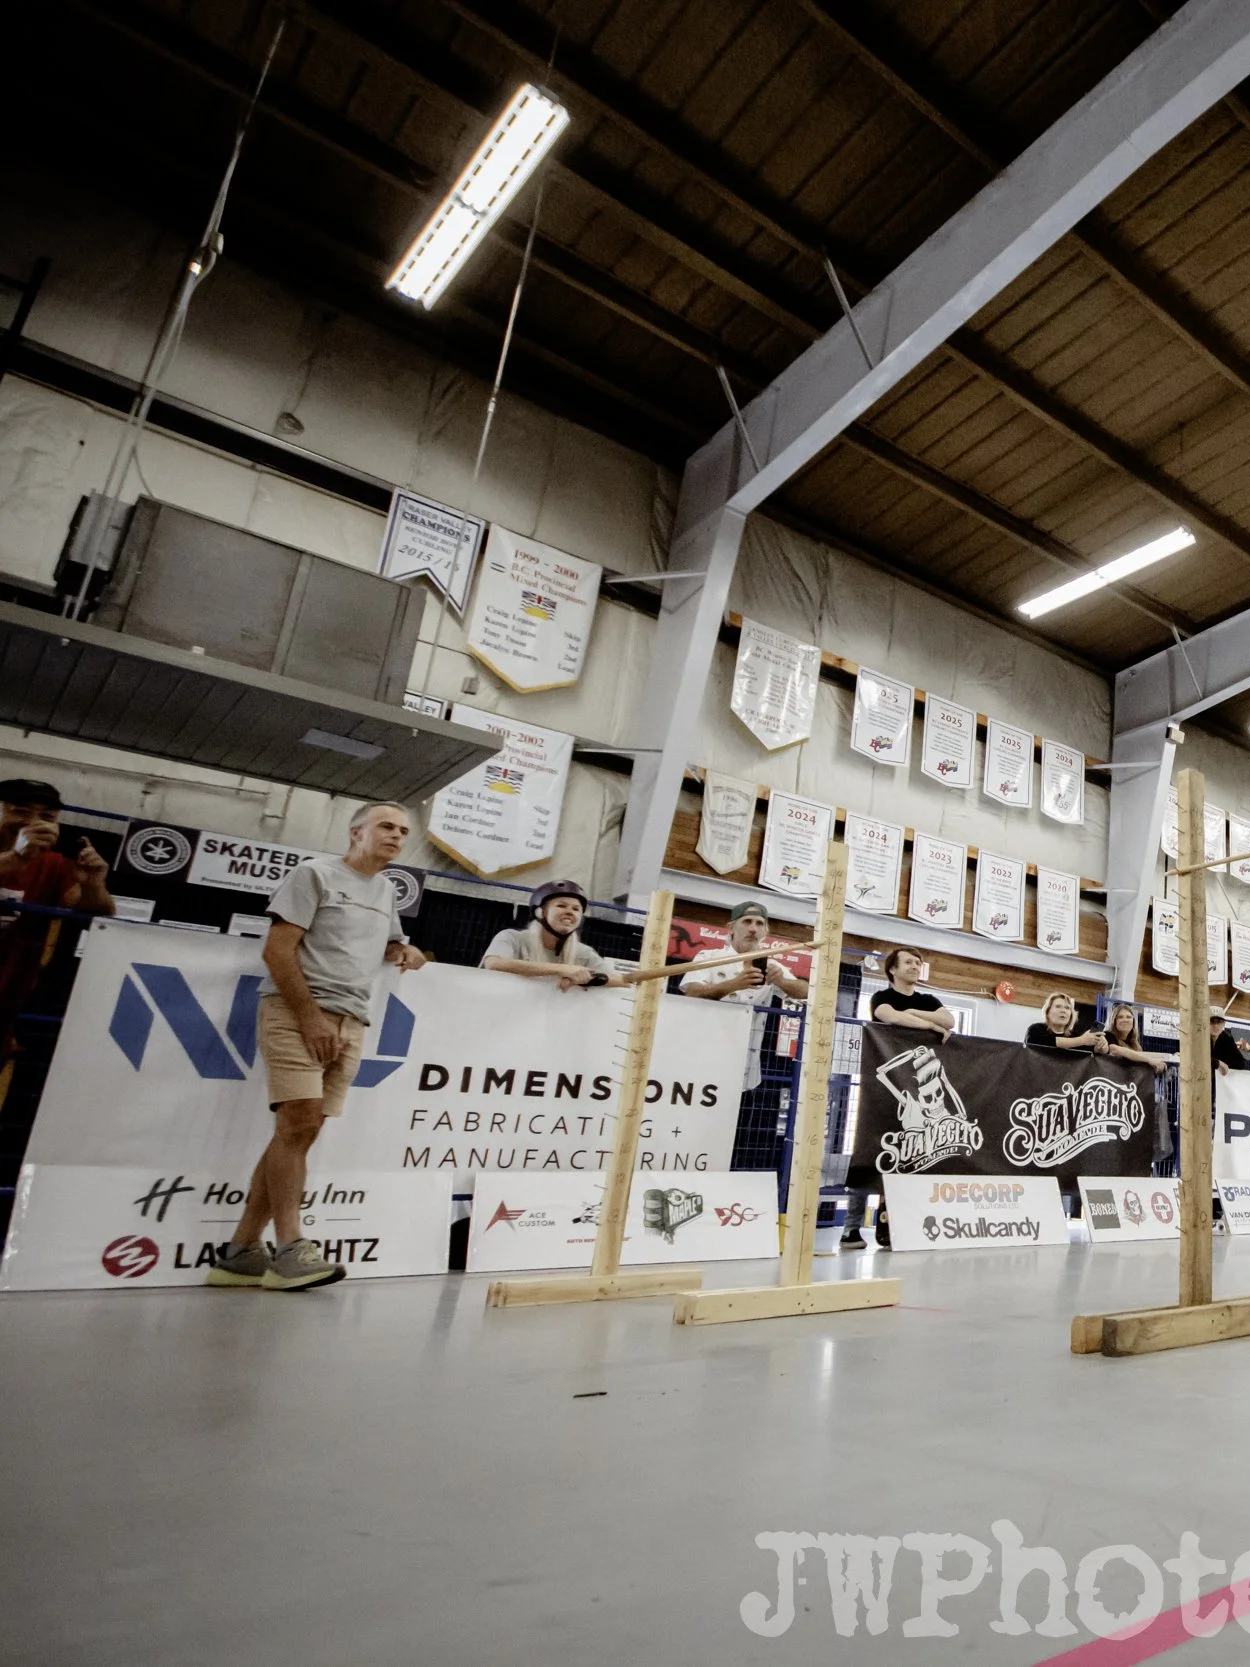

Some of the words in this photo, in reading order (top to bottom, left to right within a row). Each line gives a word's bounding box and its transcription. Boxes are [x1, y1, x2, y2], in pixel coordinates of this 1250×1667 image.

[402, 511, 471, 542] CHAMPIONS
[441, 517, 473, 533] VALLY
[398, 544, 434, 562] 2015
[514, 549, 540, 564] 1999
[404, 700, 437, 714] VALEY
[940, 712, 962, 728] 2025
[1001, 735, 1021, 750] 2025
[1055, 752, 1073, 766] 2024
[787, 809, 817, 826] 2024
[862, 828, 888, 843] 2024
[203, 838, 313, 868] SKATEB
[929, 850, 952, 865] 2023
[227, 860, 291, 881] MUS
[991, 866, 1012, 879] 2022
[418, 1063, 719, 1107] DIMENSONS
[410, 1109, 653, 1139] FABRICATIG
[1003, 1079, 1145, 1167] SUAVECITO
[875, 1117, 984, 1174] SUAVECITO
[403, 1146, 708, 1172] MANUFACTRING
[322, 1183, 366, 1204] Inn
[928, 1182, 1025, 1203] JOECORP
[1089, 1202, 1118, 1216] BONES
[1229, 1211, 1244, 1219] VAN
[518, 1219, 555, 1228] CUSTOM
[942, 1216, 1040, 1241] Skullcandy
[174, 1238, 380, 1269] LAYHTZ
